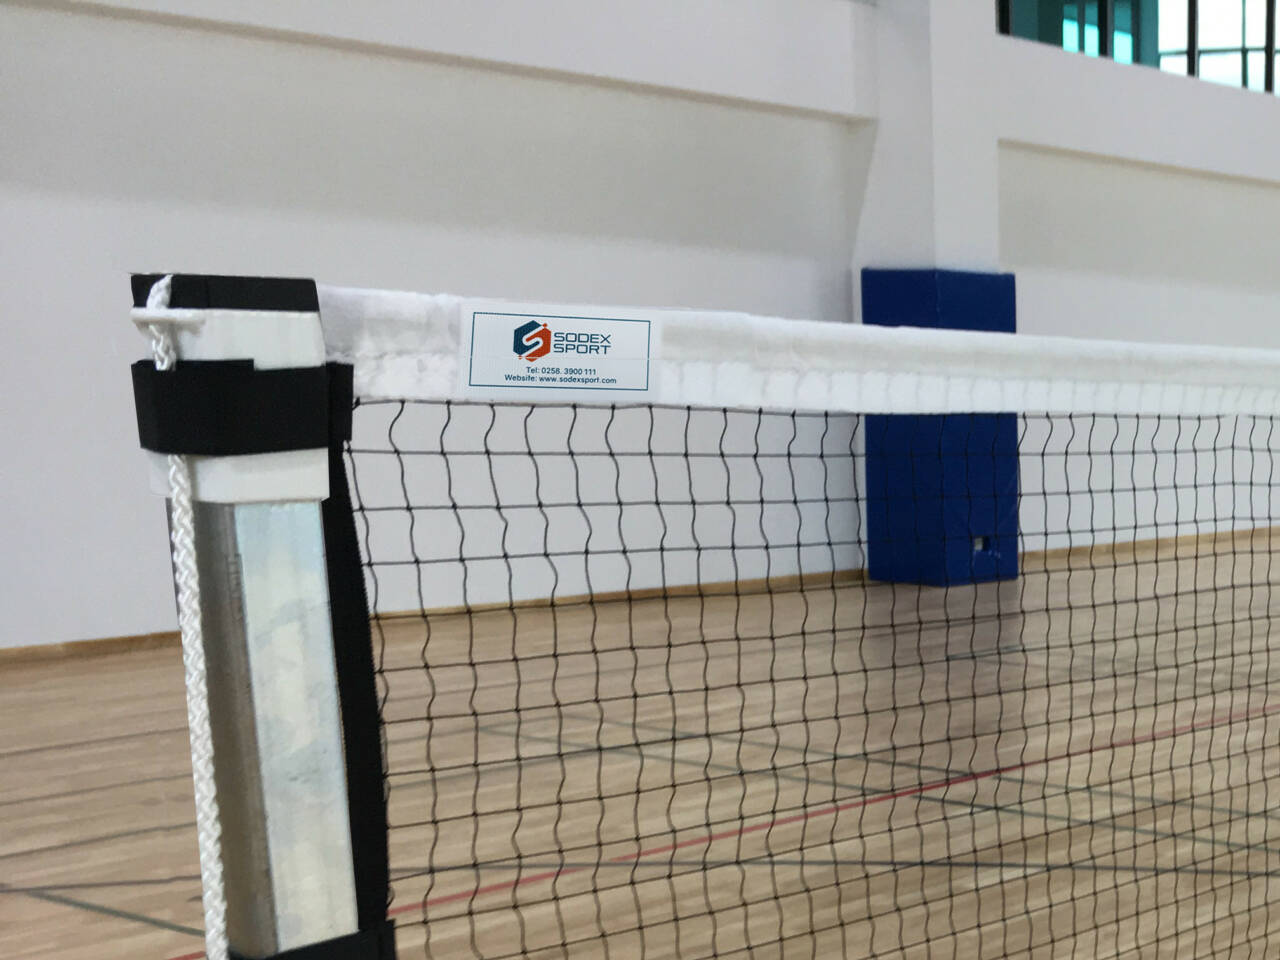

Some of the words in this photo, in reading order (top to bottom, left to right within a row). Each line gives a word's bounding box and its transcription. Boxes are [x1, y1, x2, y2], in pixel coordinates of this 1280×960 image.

[553, 332, 612, 345] SODEX
[553, 343, 612, 355] SPORT
[526, 366, 540, 374] Tel:
[563, 367, 582, 375] 3900
[504, 374, 537, 382] Website:
[539, 375, 617, 384] www.sodexsport.com
